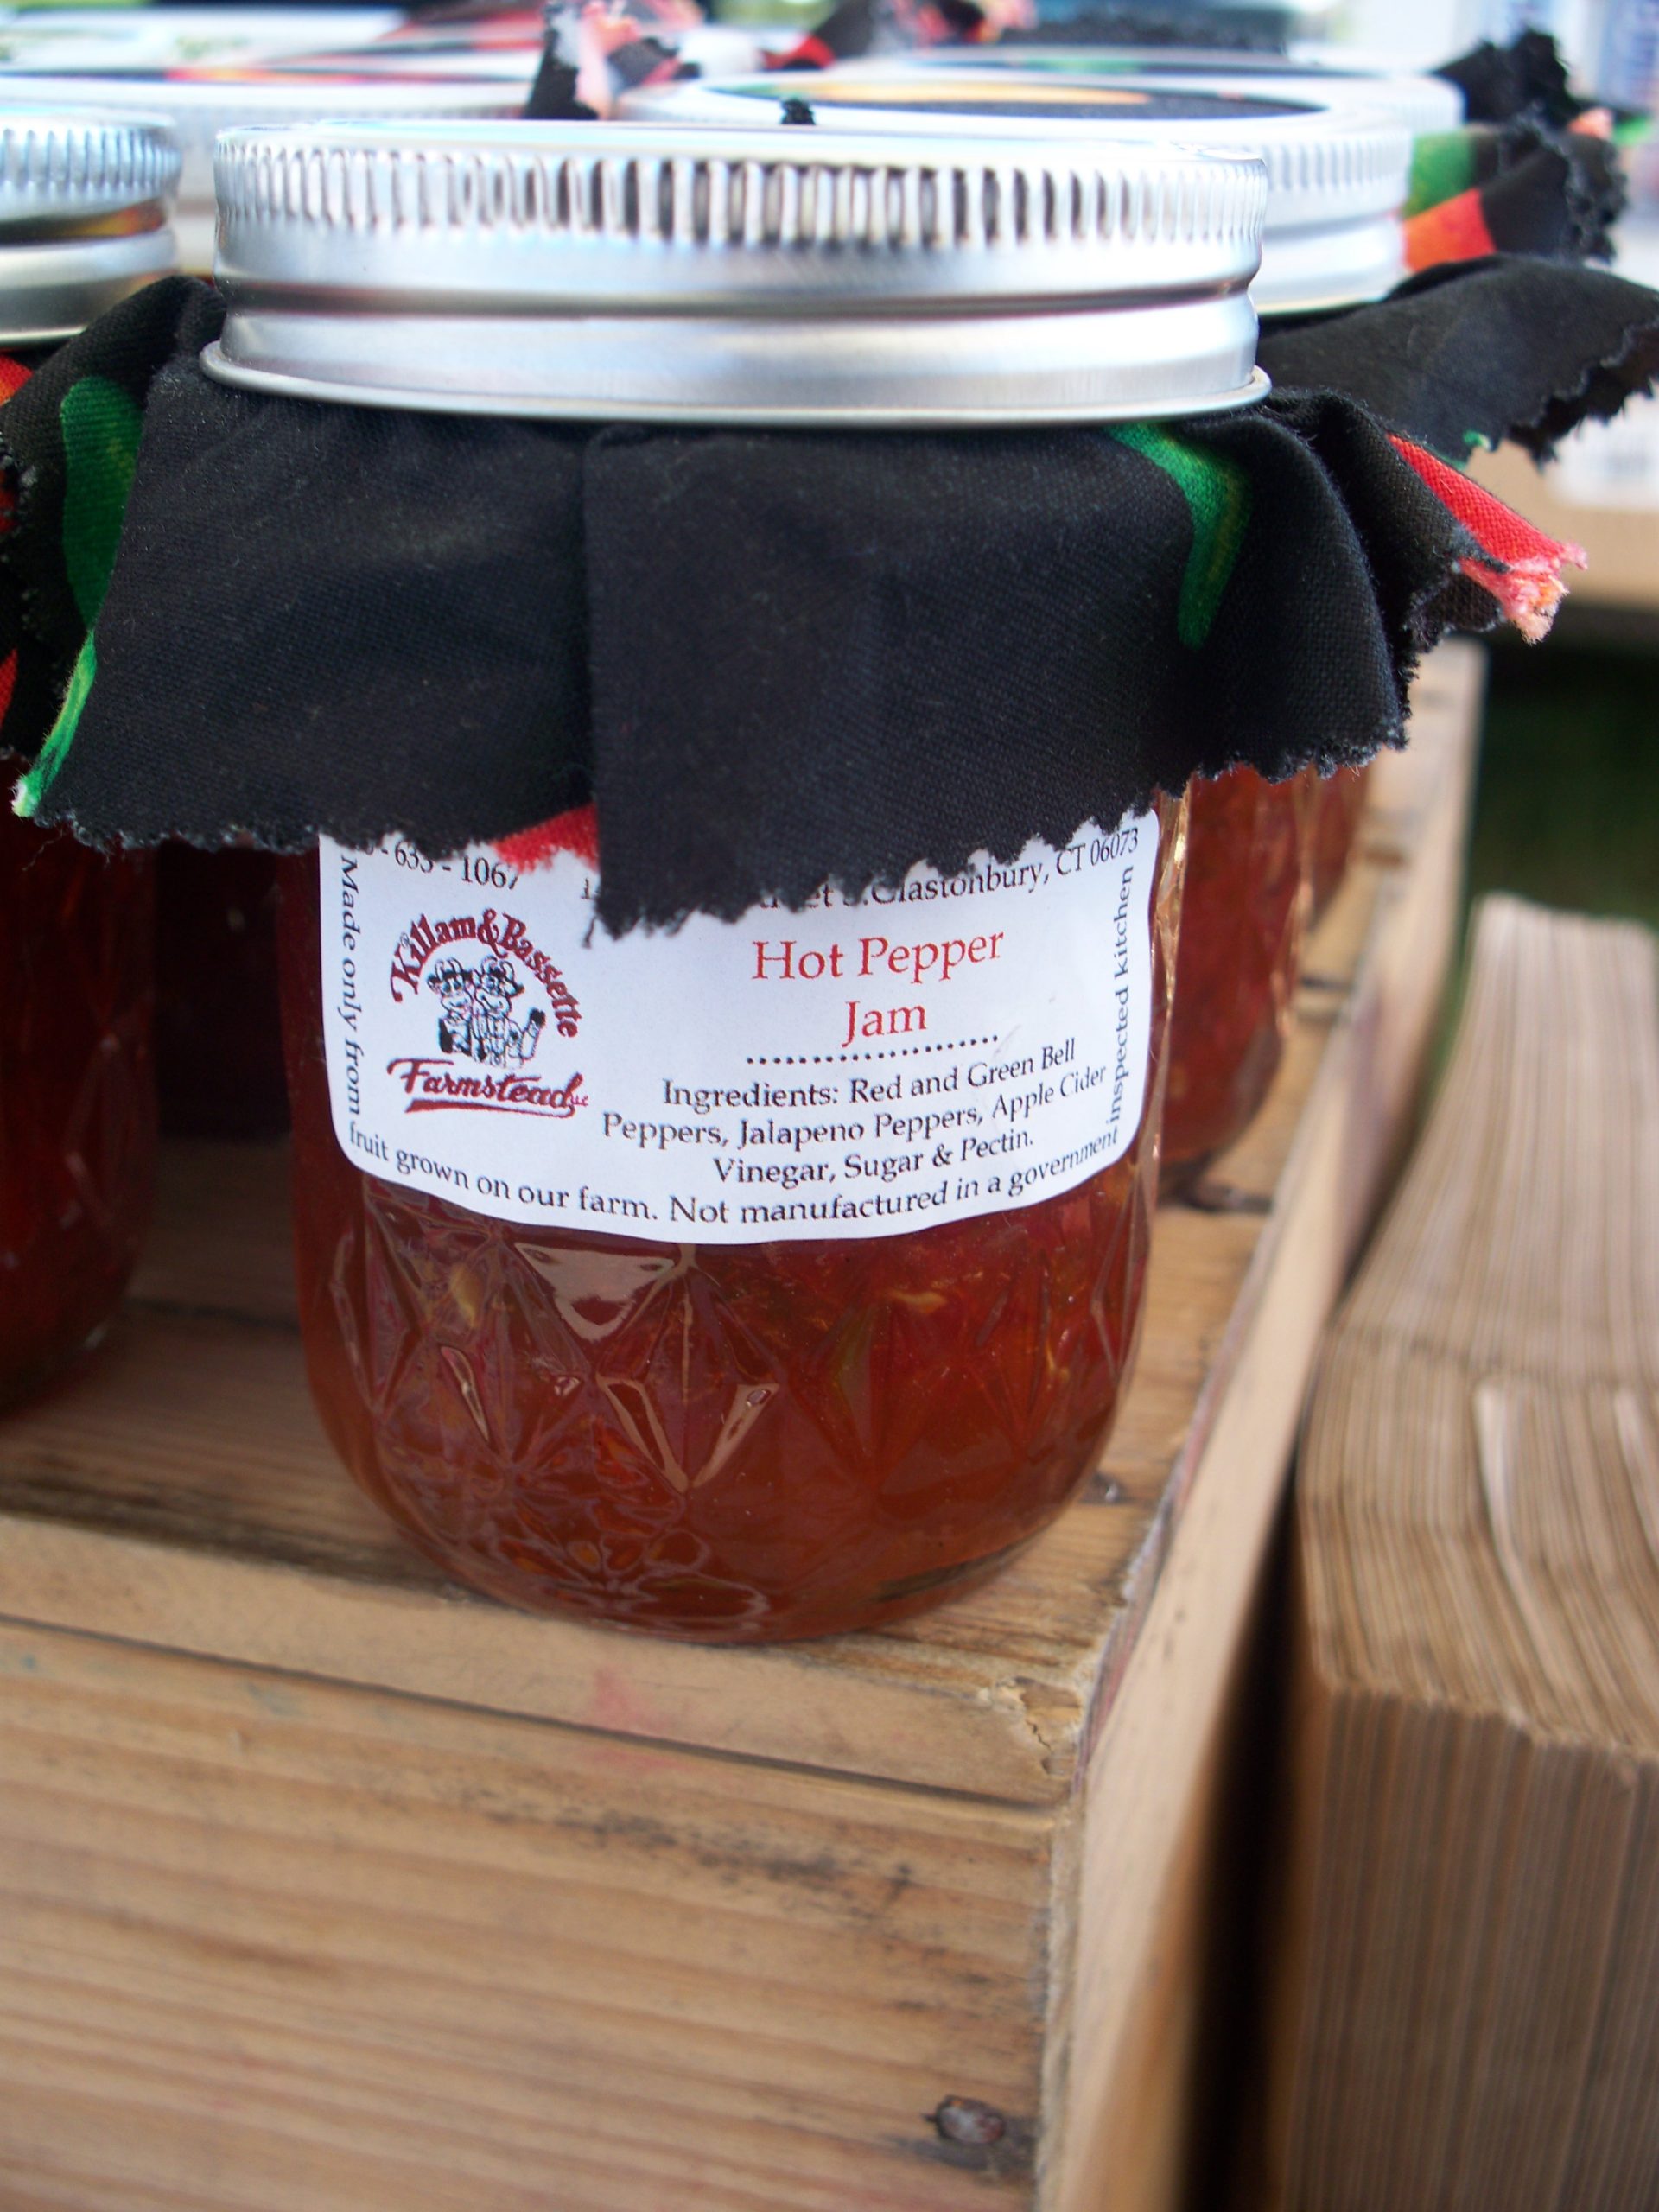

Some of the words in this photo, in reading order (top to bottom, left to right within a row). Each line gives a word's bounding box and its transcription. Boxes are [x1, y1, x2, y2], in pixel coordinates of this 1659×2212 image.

[1056, 843, 1086, 876] CT
[1090, 827, 1139, 867] 06073
[340, 855, 361, 949] Made
[1113, 866, 1135, 981] kitchen
[751, 939, 844, 980] Hot
[857, 931, 1004, 985] Pepper
[337, 957, 362, 1033] only
[842, 1000, 928, 1048] Jam
[345, 1039, 365, 1116] from
[664, 1079, 839, 1115] Ingredients:
[849, 1076, 901, 1105] Red
[910, 1068, 959, 1096] and
[967, 1058, 1035, 1089] Green
[1040, 1038, 1076, 1071] Bell
[1105, 986, 1130, 1126] inspected
[386, 1058, 582, 1109] Farmstead
[603, 1111, 729, 1150] Peppers,
[738, 1118, 865, 1152] Jalapeno
[874, 1104, 983, 1141] Peppers,
[991, 1088, 1055, 1125] Apple
[1059, 1063, 1107, 1098] Cider
[349, 1122, 389, 1162] fruit
[715, 1154, 836, 1189] Vinegar,
[843, 1149, 925, 1183] Sugar
[932, 1144, 953, 1167] &
[960, 1129, 1034, 1162] Pectin.
[1009, 1127, 1119, 1197] government
[396, 1147, 469, 1190] grown
[478, 1176, 511, 1199] on
[956, 1170, 980, 1199] in
[988, 1177, 1001, 1194] a
[518, 1184, 569, 1207] our
[579, 1186, 658, 1221] farm.
[669, 1194, 730, 1224] Not
[740, 1180, 949, 1224] manufactured
